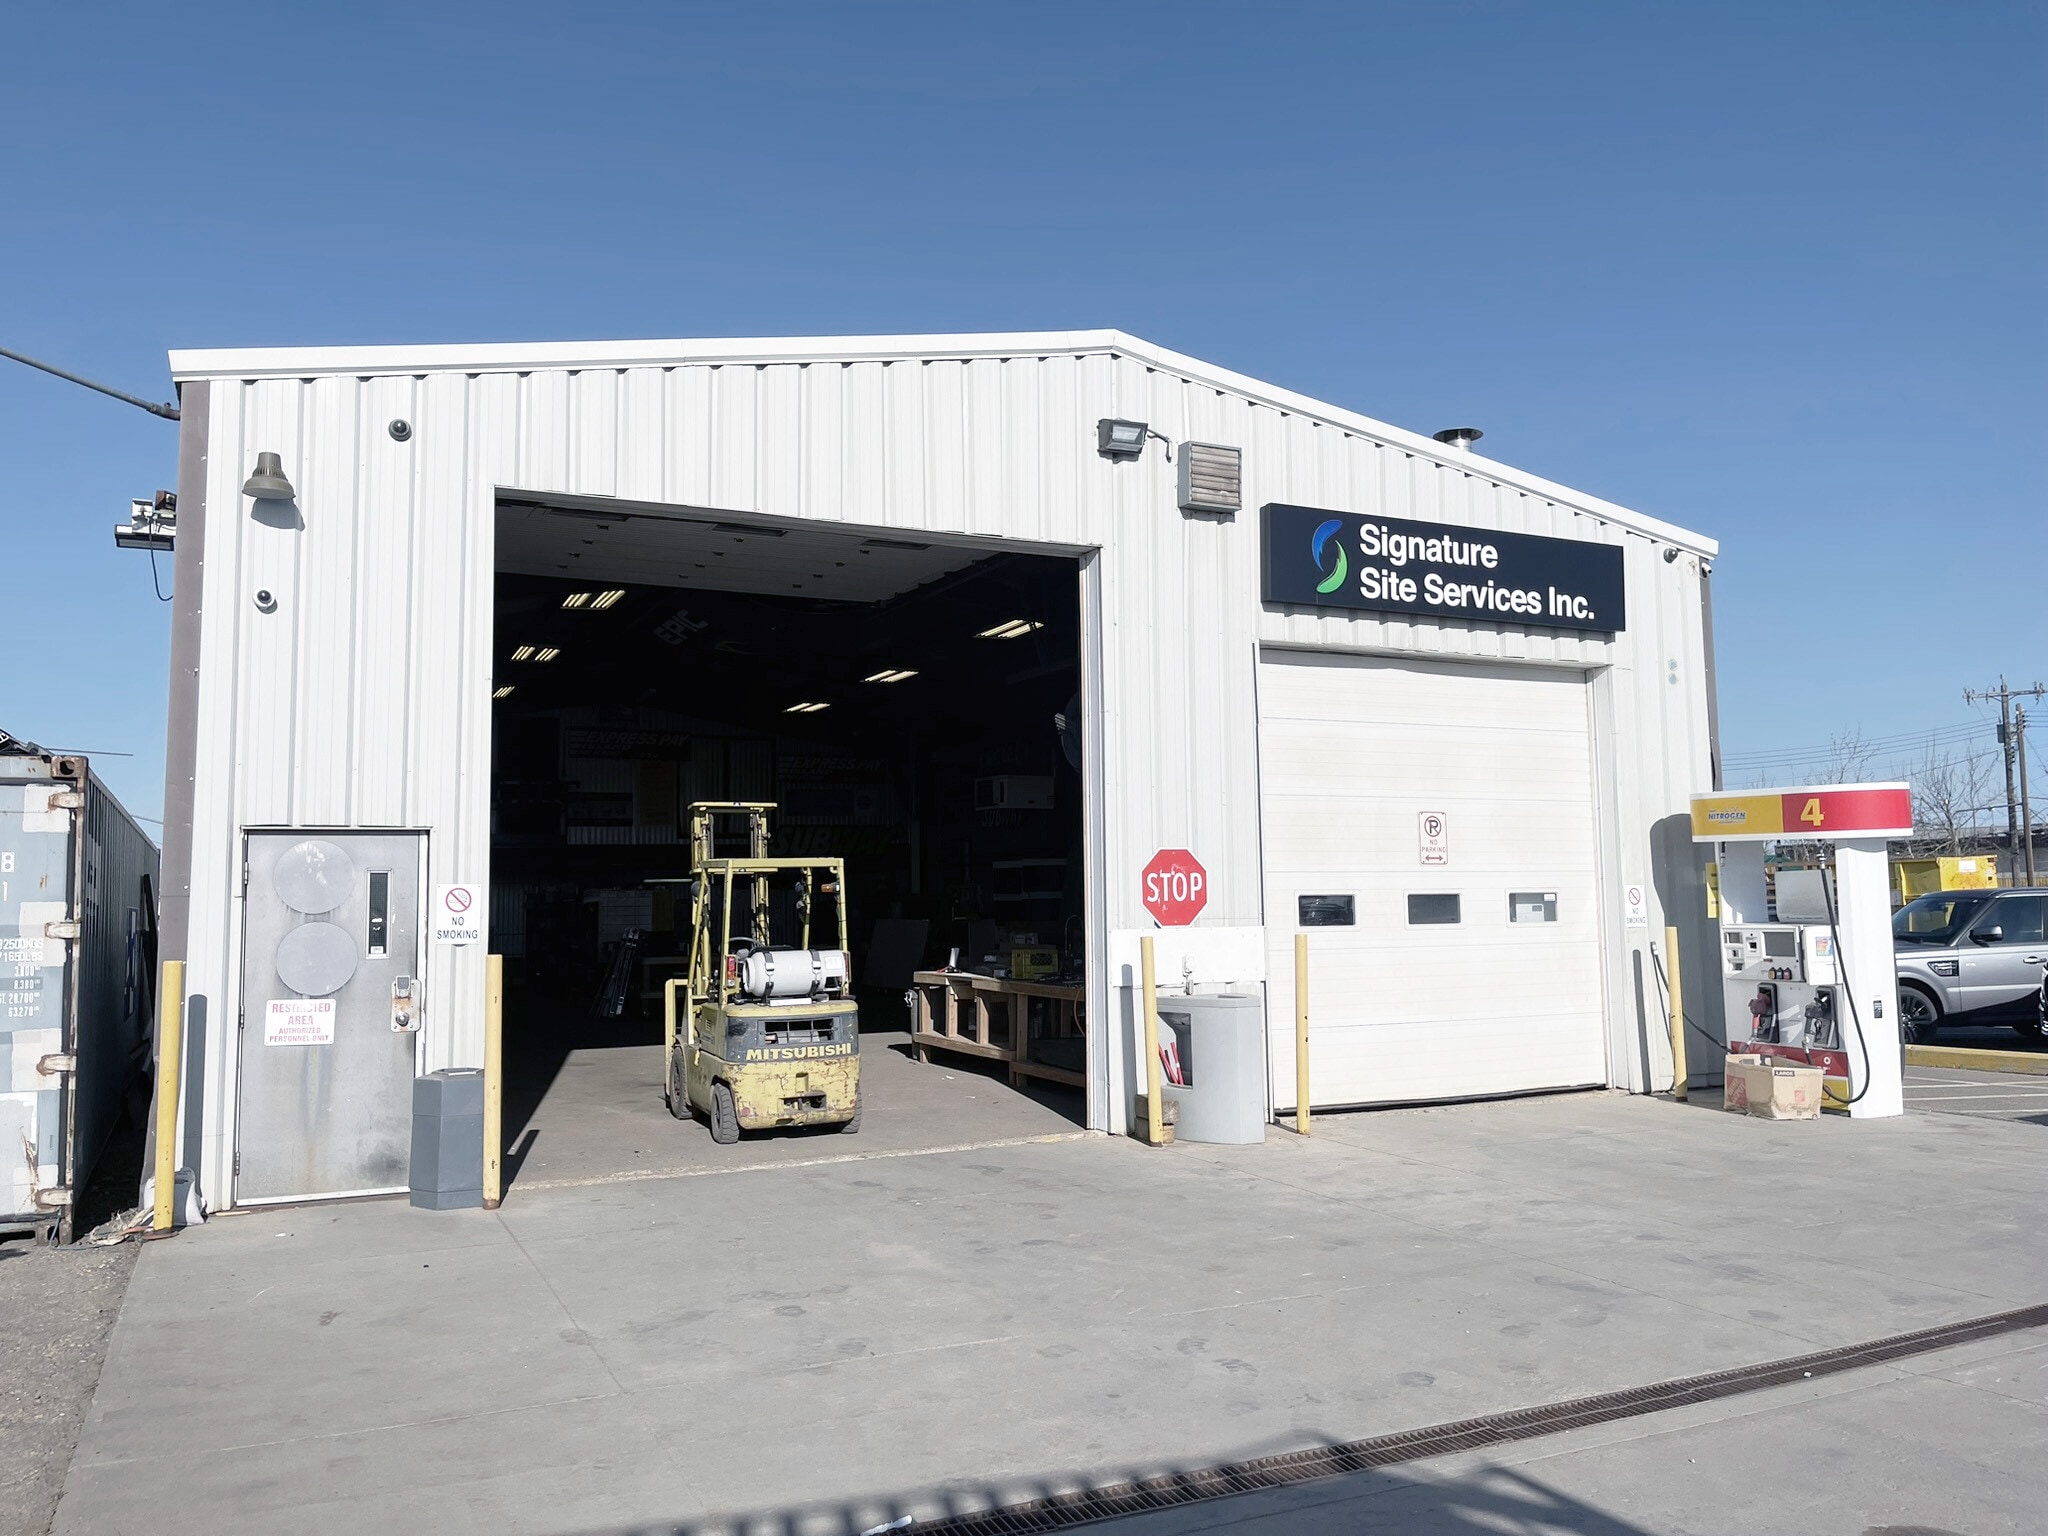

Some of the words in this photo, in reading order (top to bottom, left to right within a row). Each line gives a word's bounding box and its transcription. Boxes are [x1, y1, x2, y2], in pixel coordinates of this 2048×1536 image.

[1359, 523, 1498, 569] Signature
[1359, 567, 1417, 602] Site
[1424, 573, 1542, 615] Services
[1548, 586, 1595, 619] Inc.
[1708, 812, 1746, 820] NITROGEN
[1800, 798, 1824, 827] 4
[1146, 872, 1203, 903] STOP
[451, 916, 465, 926] NO
[436, 929, 478, 940] SMOKING
[287, 1015, 314, 1025] AREA
[278, 1027, 321, 1035] AUTHORIZED
[269, 1035, 310, 1043] PERSONNEL
[746, 1043, 851, 1061] MITSUBISHI
